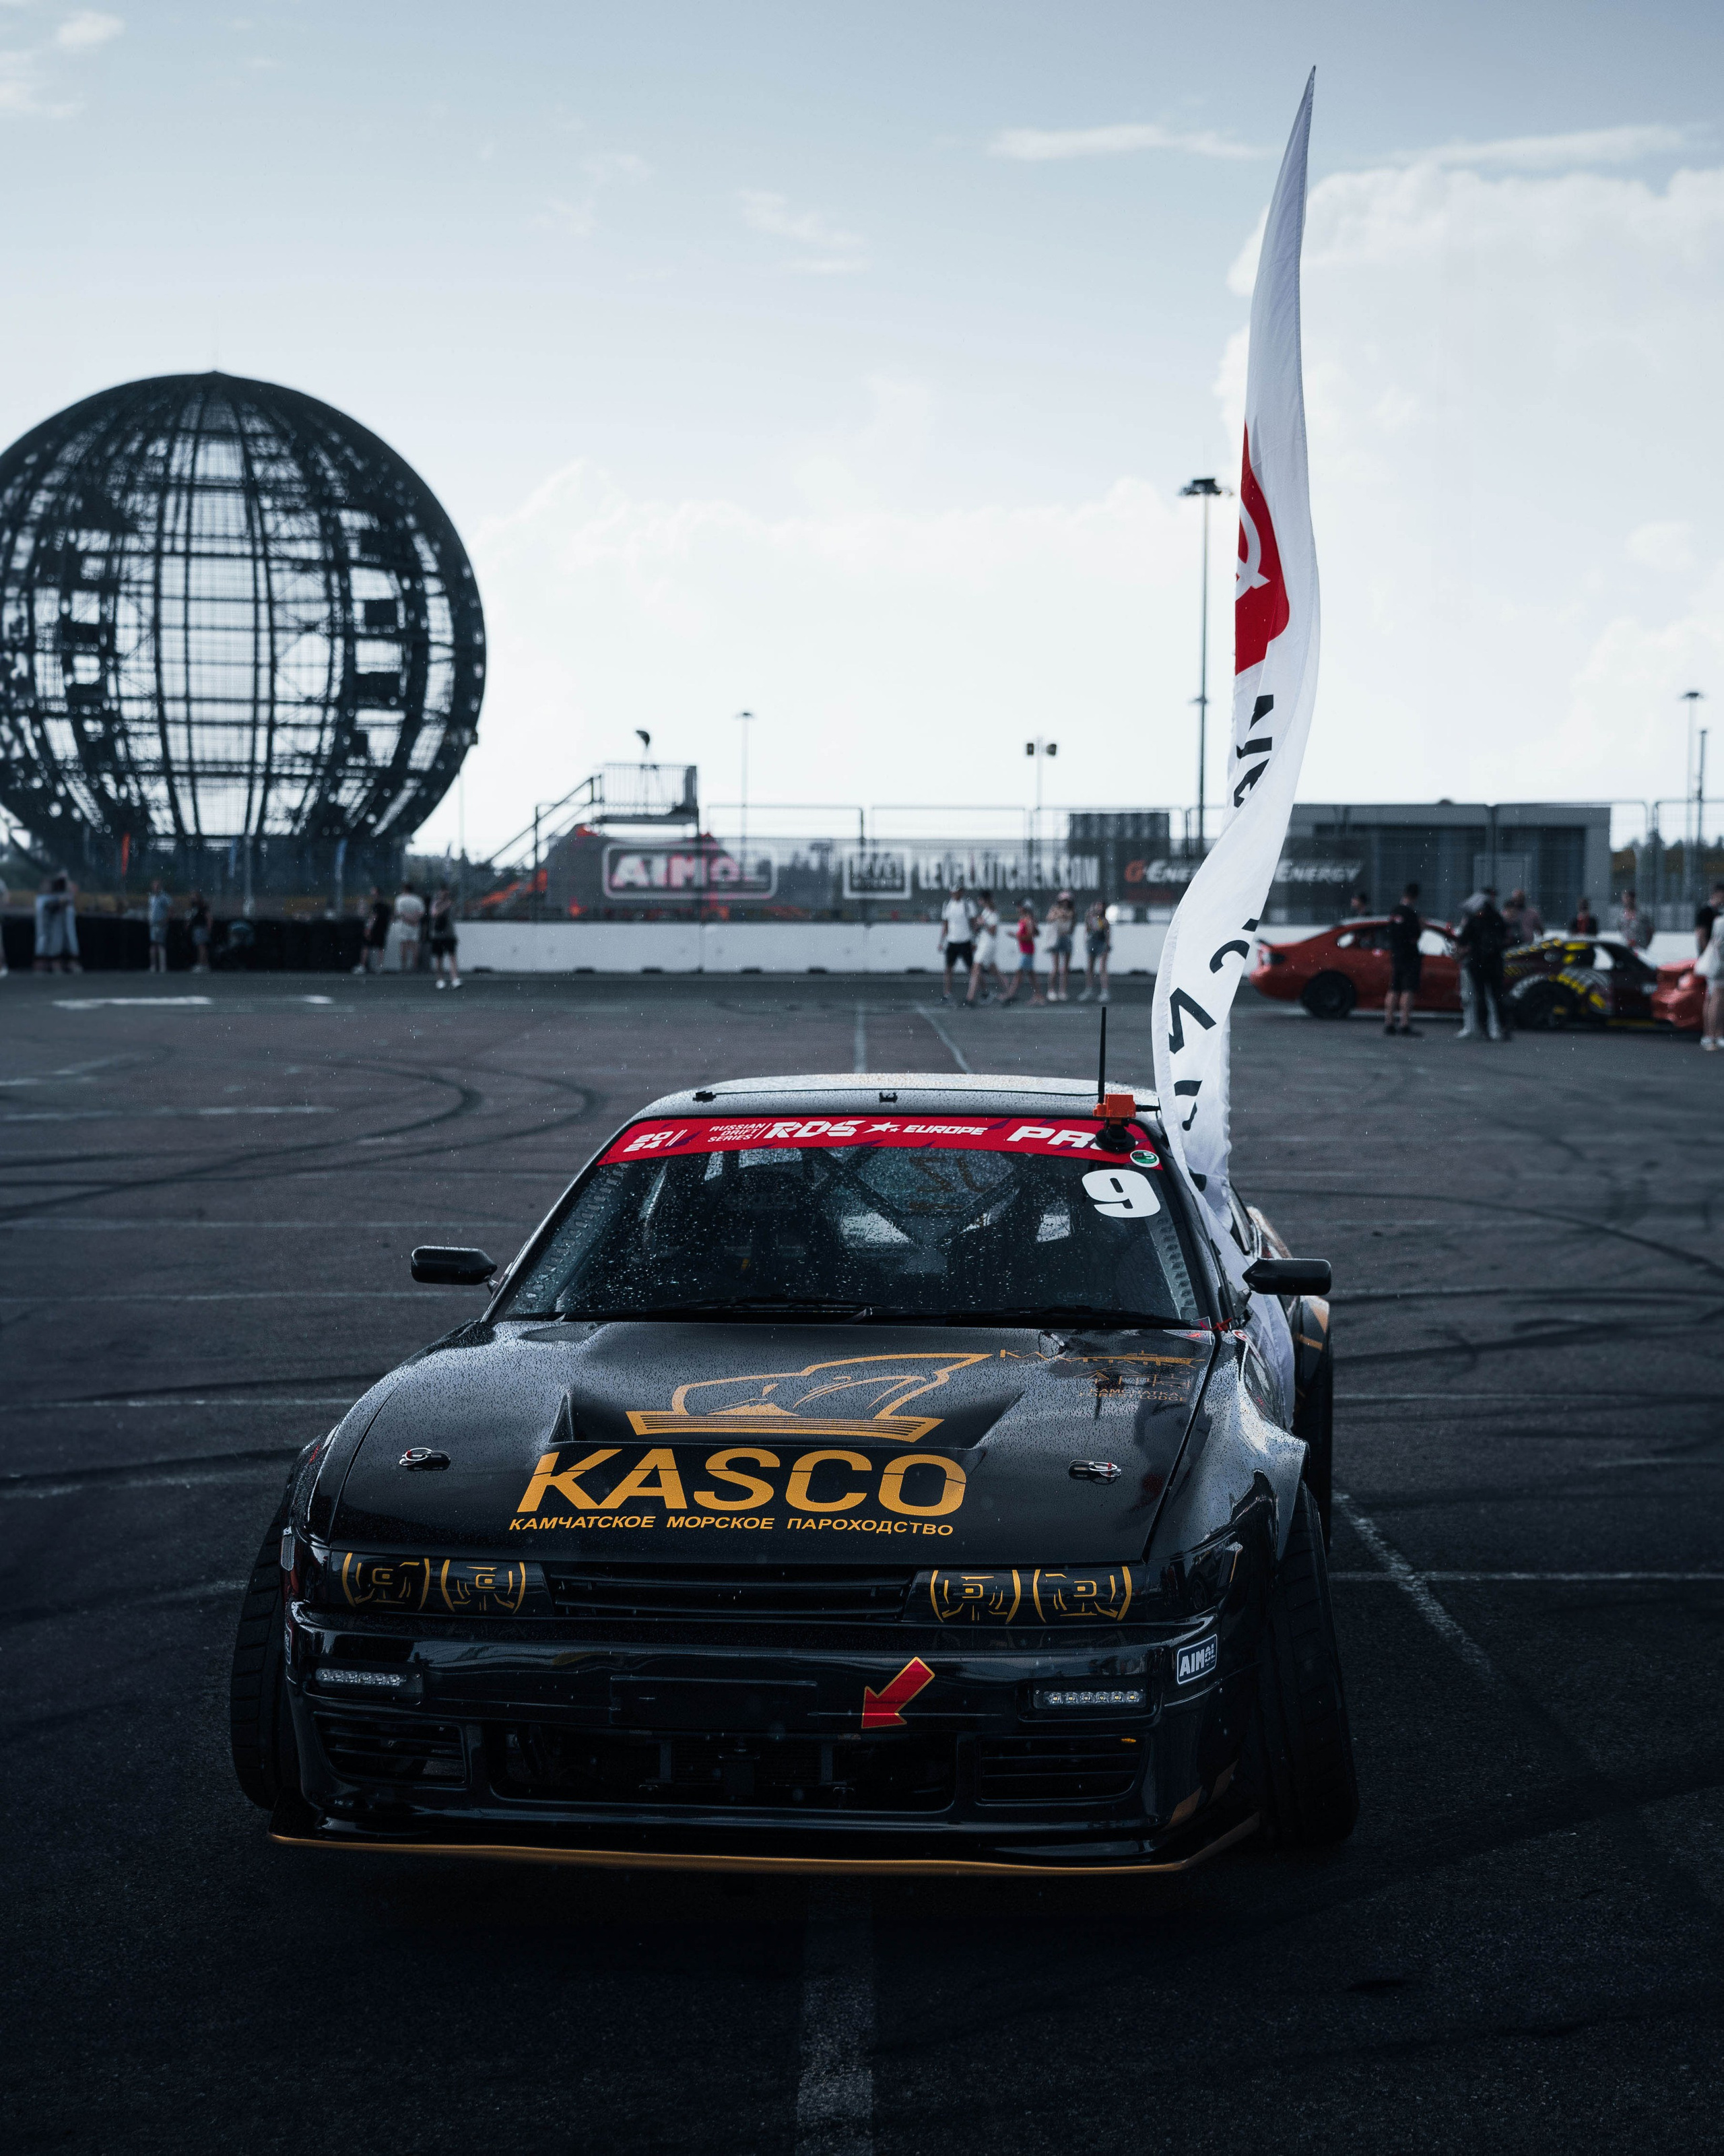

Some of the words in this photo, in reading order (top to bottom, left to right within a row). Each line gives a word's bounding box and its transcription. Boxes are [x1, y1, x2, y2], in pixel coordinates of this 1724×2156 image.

[709, 1123, 766, 1132] RUSSIAN
[763, 1120, 867, 1139] RDS
[902, 1125, 988, 1136] EUROPE
[707, 1134, 753, 1142] SERIES
[1007, 1125, 1138, 1150] PR
[1082, 1169, 1161, 1218] 9
[1139, 1394, 1189, 1402] LODGE
[517, 1447, 968, 1517] KASCO
[509, 1516, 656, 1530] КАМЧАТСКОЕ
[666, 1516, 775, 1530] МОРСКОЕ
[787, 1517, 954, 1536] ПАРОХОДСТВО
[1179, 1643, 1216, 1677] AIMOL
